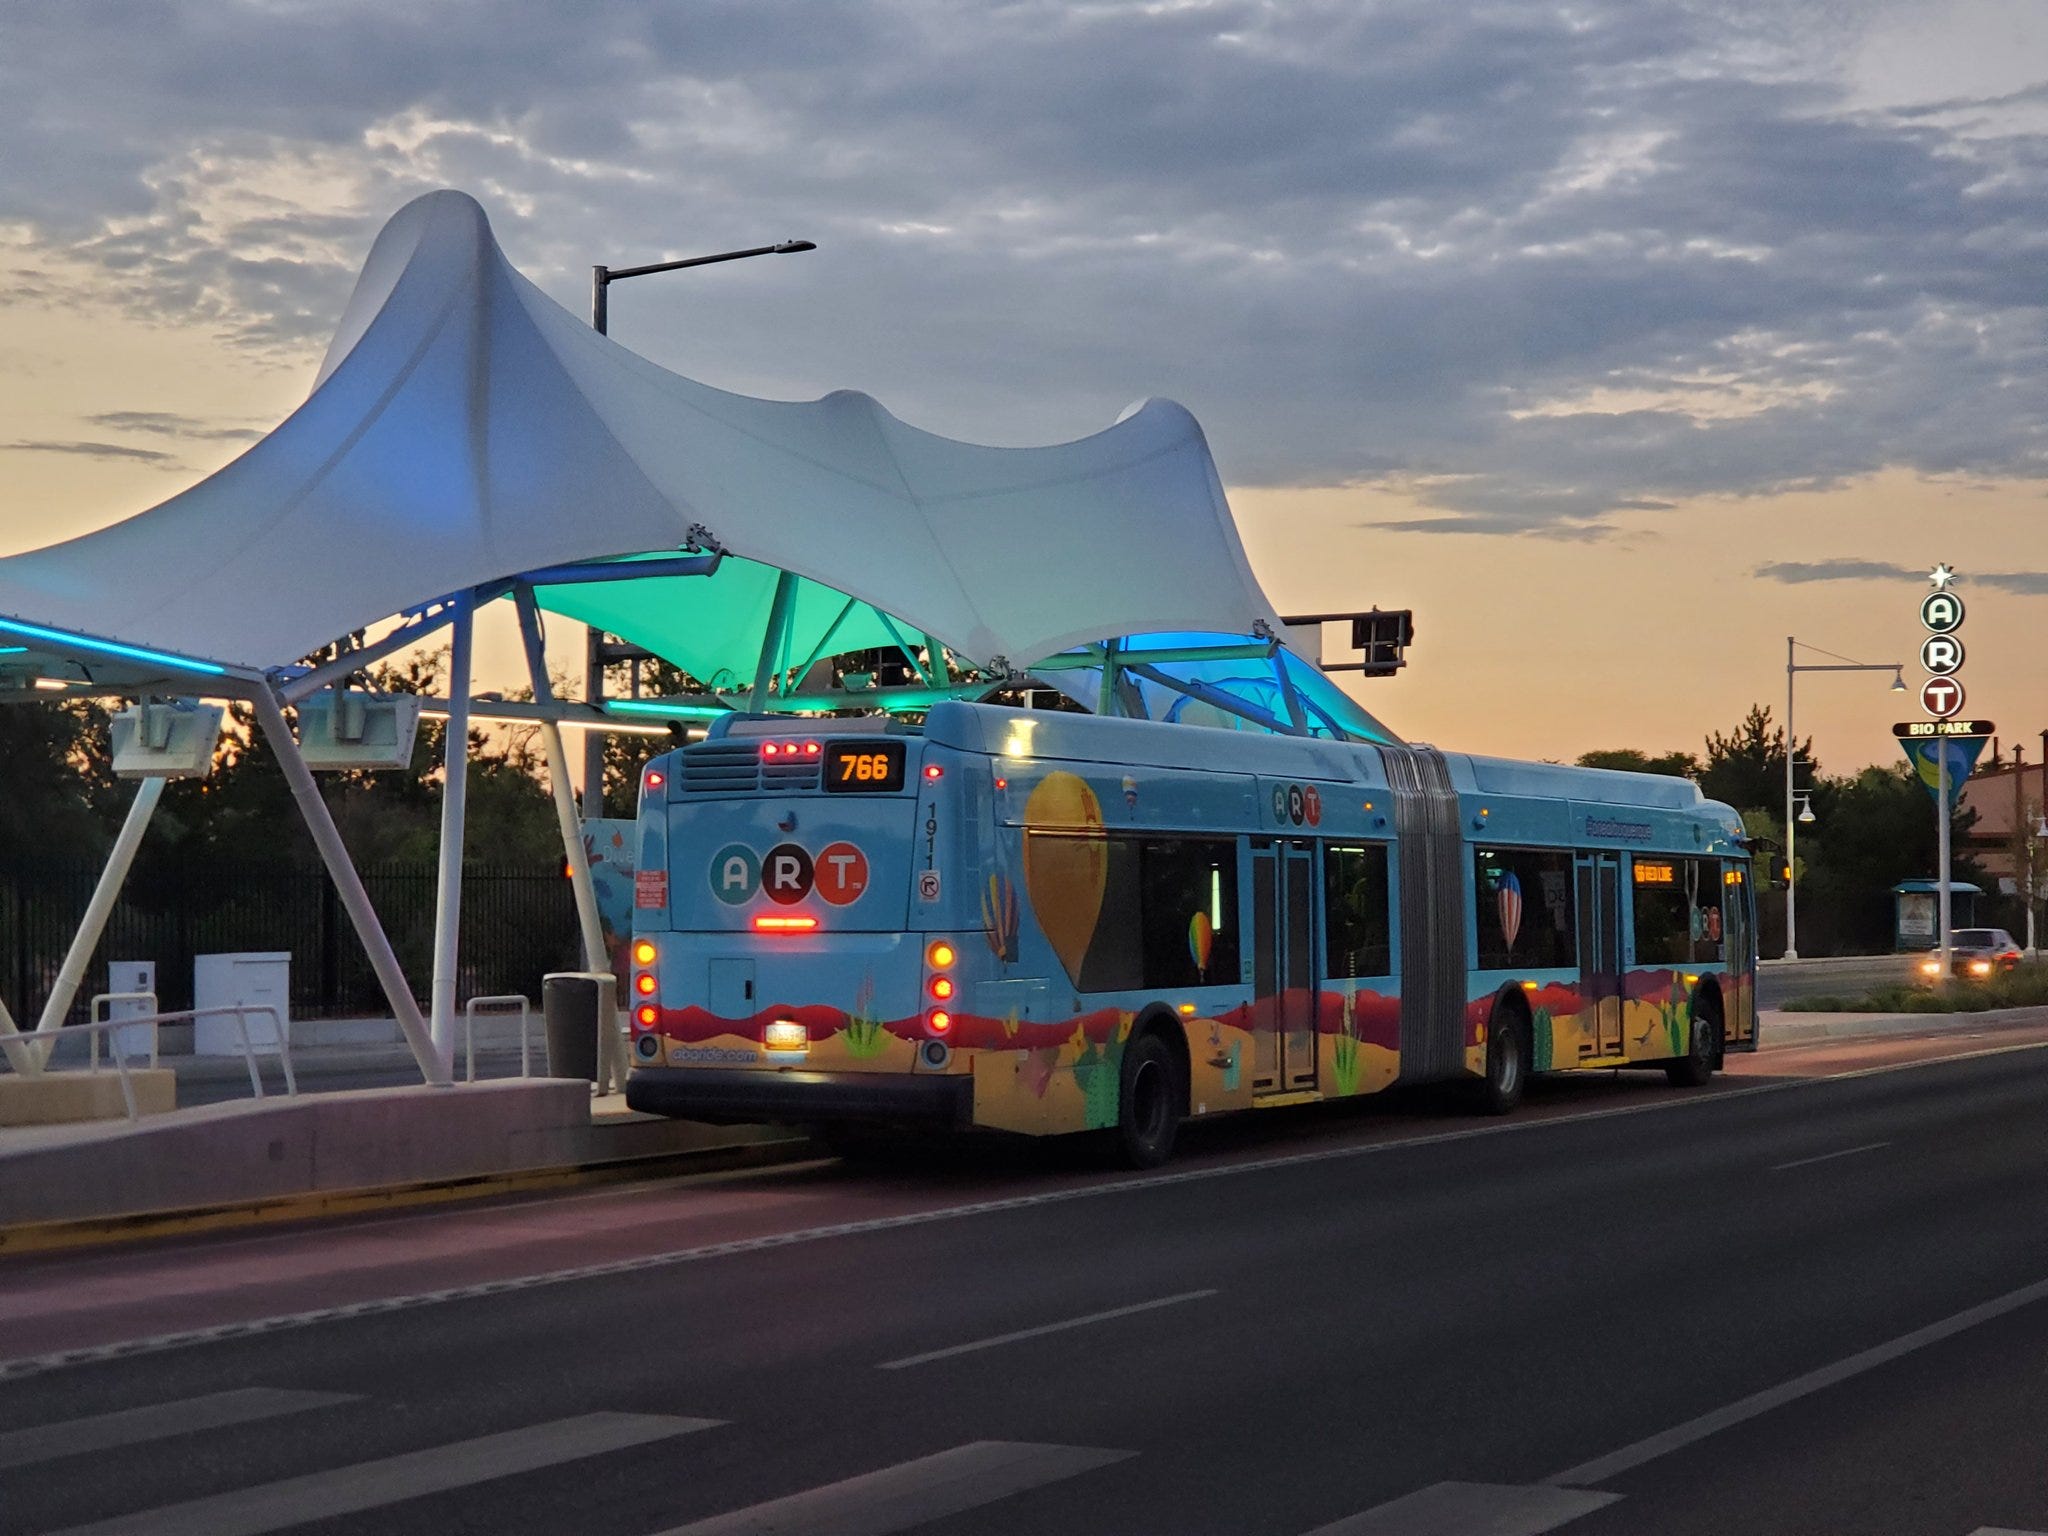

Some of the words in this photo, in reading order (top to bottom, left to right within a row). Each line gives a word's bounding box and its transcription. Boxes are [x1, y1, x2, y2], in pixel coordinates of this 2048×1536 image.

[1927, 598, 1956, 712] ART
[1909, 723, 1935, 735] BIO
[1937, 722, 1973, 735] PARK
[840, 755, 888, 781] 766
[1276, 792, 1317, 815] ART
[926, 802, 937, 870] 1911
[723, 855, 856, 890] ART
